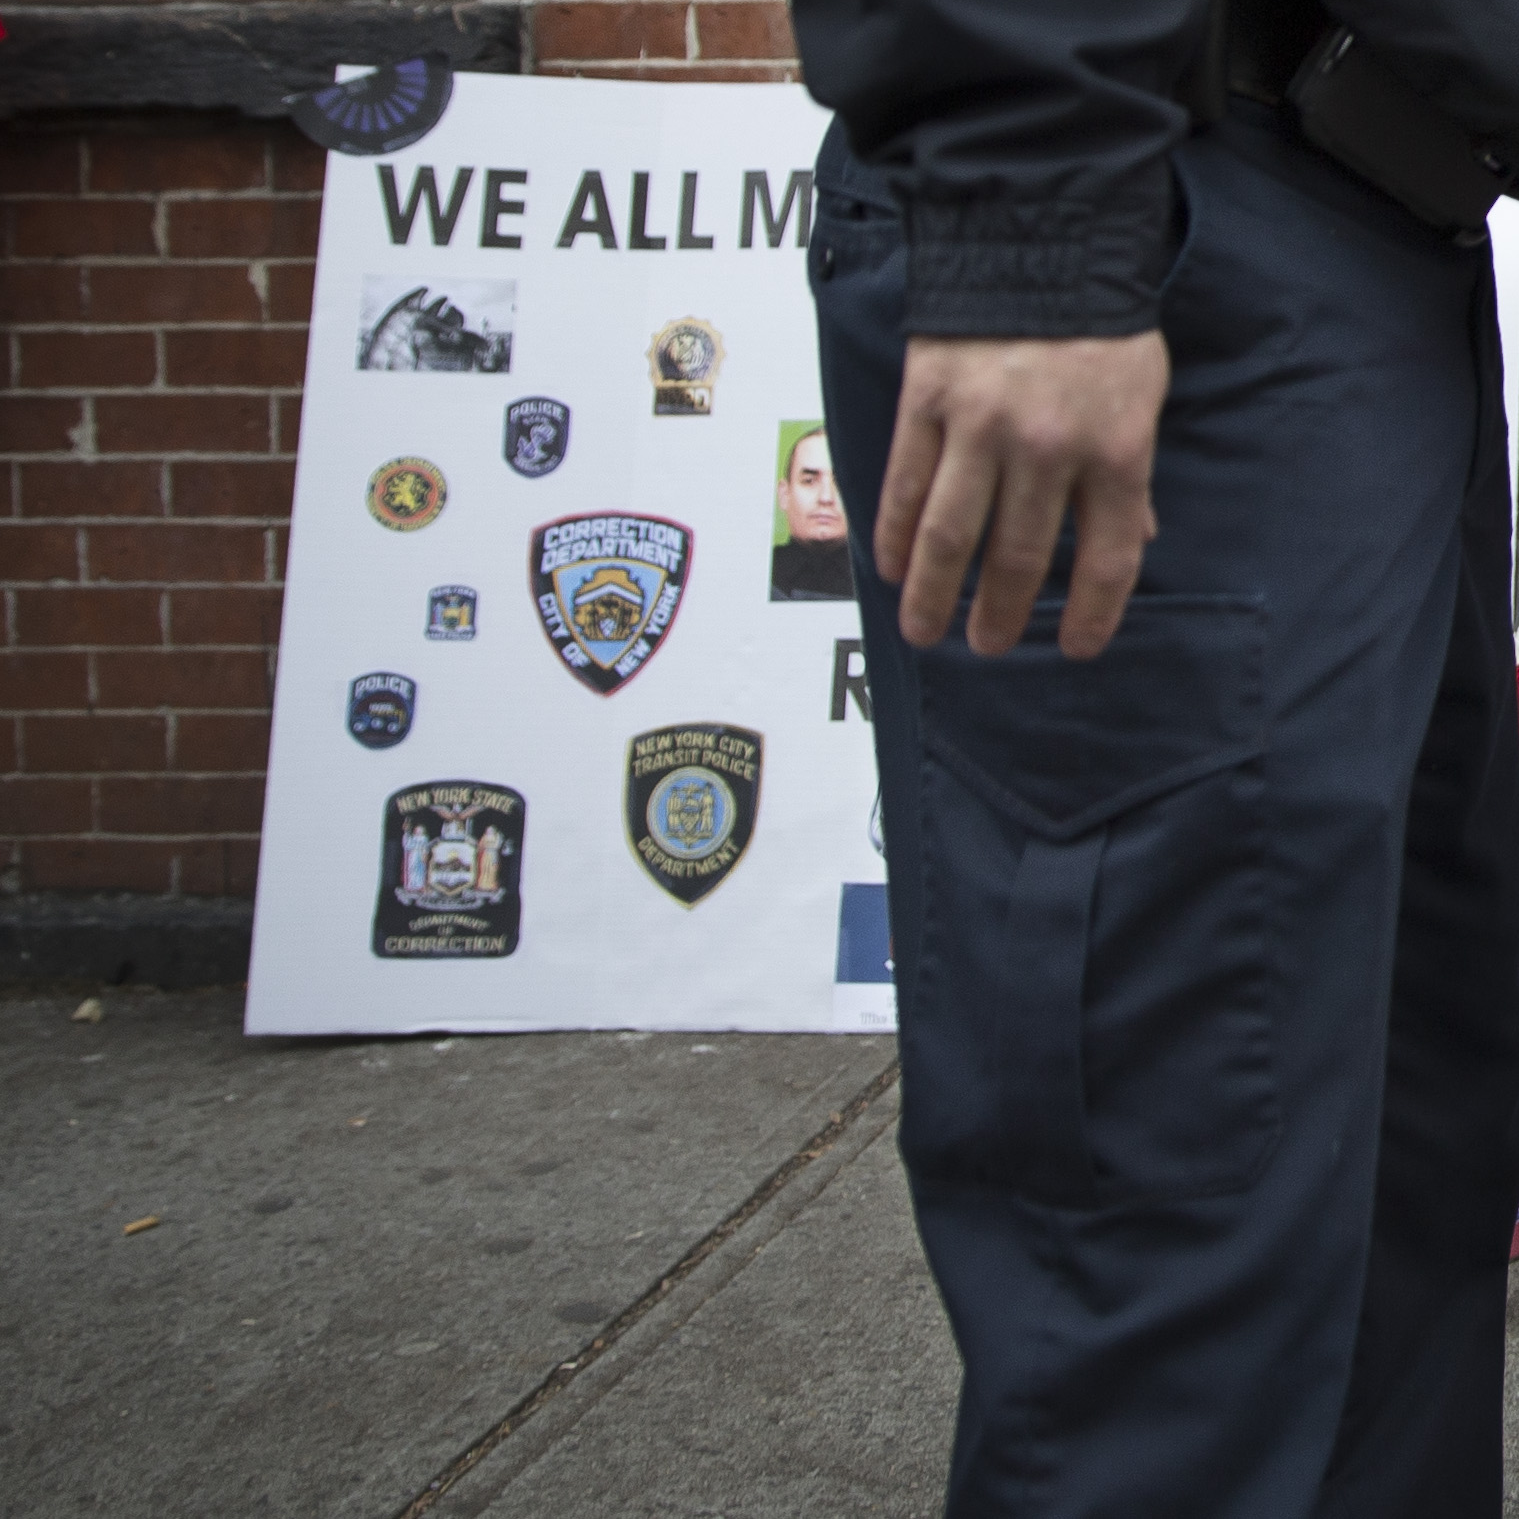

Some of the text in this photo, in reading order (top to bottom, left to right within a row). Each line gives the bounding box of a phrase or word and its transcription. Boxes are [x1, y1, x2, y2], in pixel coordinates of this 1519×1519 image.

[377, 164, 529, 250] WE
[554, 170, 716, 252] ALL
[510, 400, 564, 423] POLICE
[543, 517, 684, 551] CORRECTION
[540, 537, 683, 574] DEPARTMENT
[538, 581, 682, 679] CITY OF NEW YORK
[354, 675, 412, 699] POLICE
[636, 731, 756, 760] NEW YORK CITY
[632, 748, 755, 782] TRANSIT POLICE
[396, 786, 516, 816] NEW YORK STATE
[637, 835, 740, 877] DEPARTMENT
[384, 934, 508, 955] CORRECTION
